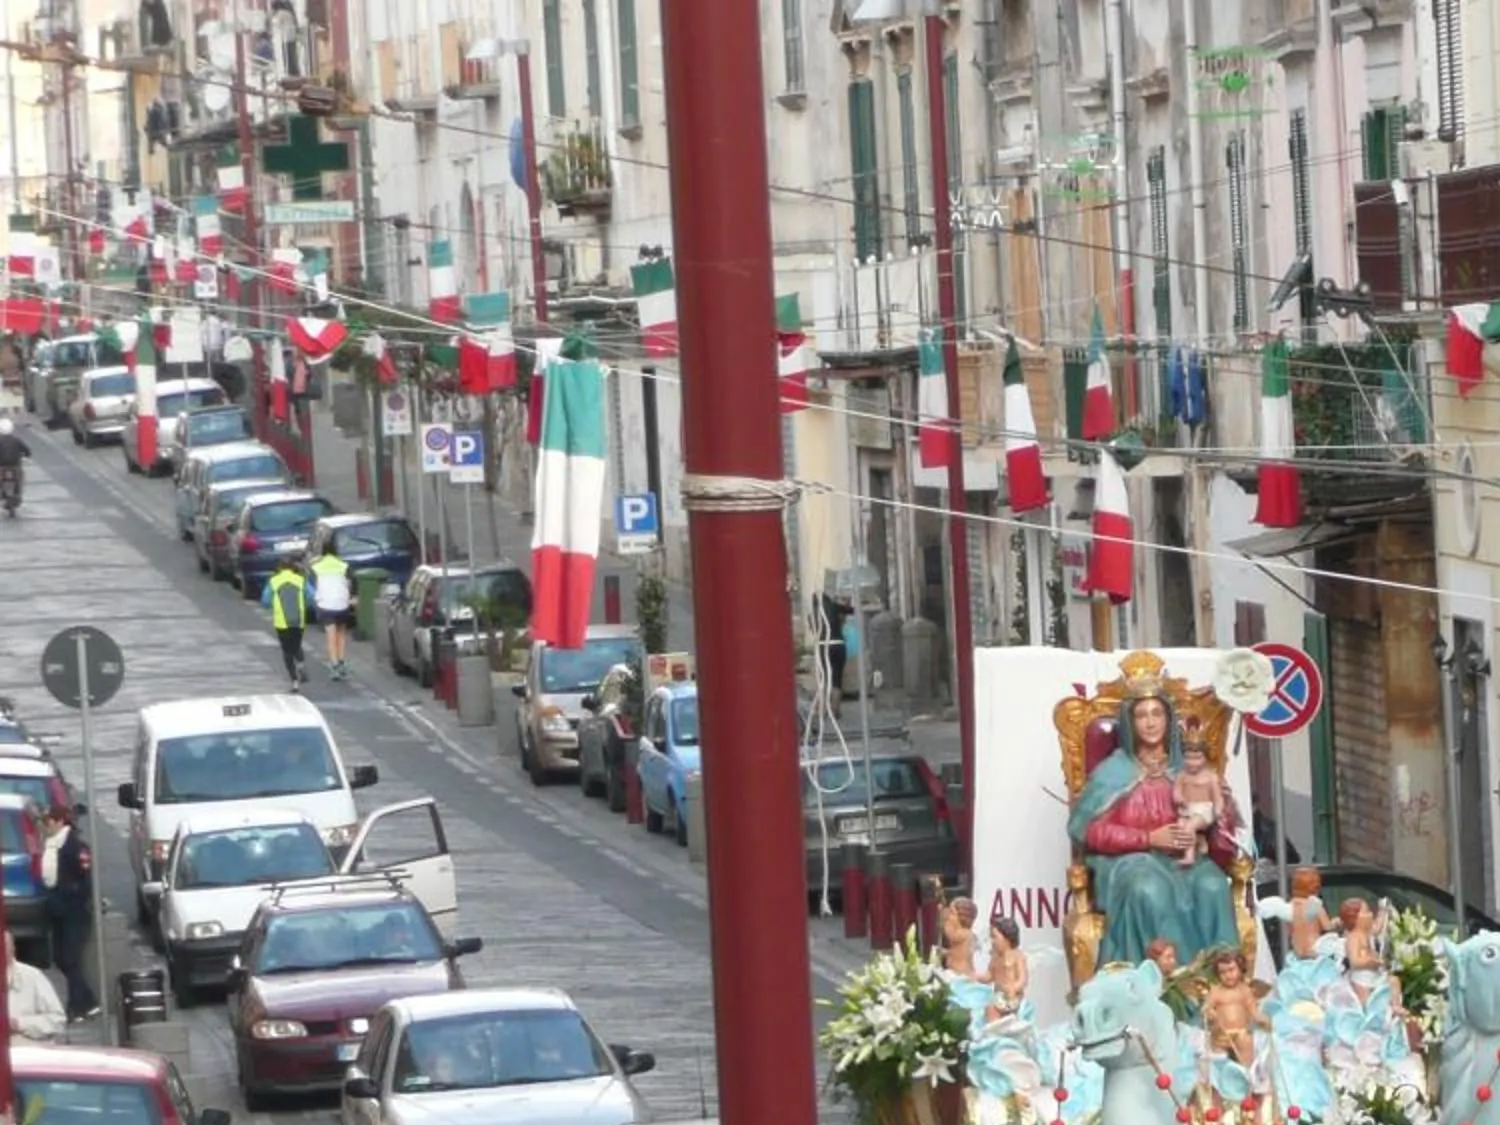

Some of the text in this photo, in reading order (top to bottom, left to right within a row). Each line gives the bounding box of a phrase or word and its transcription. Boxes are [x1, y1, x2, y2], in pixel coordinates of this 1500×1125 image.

[455, 435, 476, 463] P
[623, 497, 649, 531] P
[989, 887, 1073, 929] ANN
